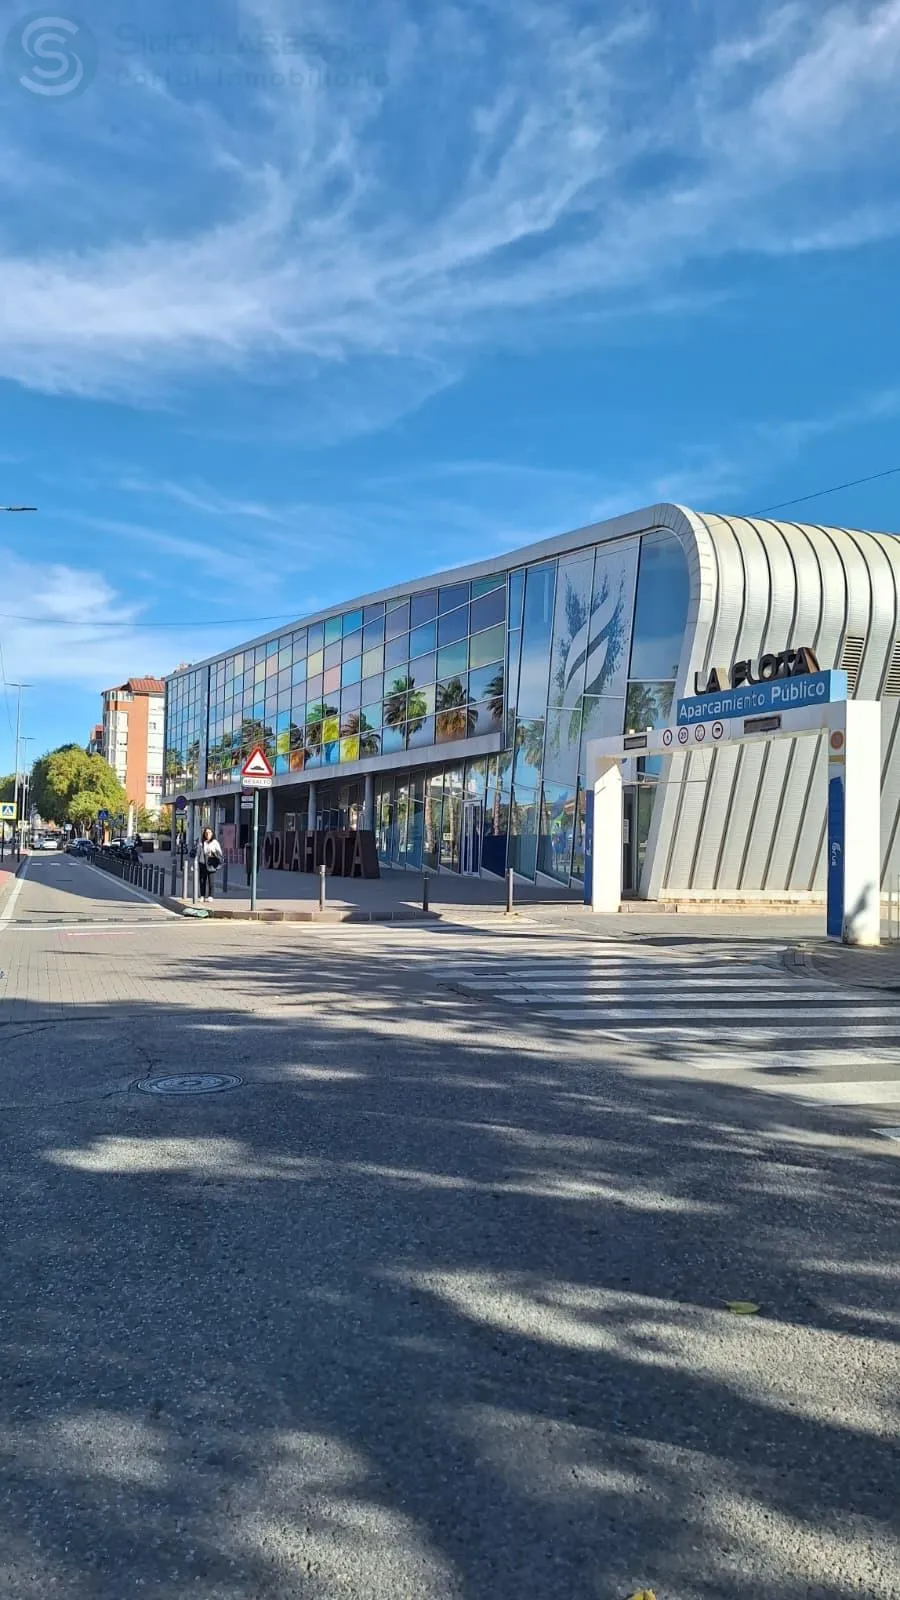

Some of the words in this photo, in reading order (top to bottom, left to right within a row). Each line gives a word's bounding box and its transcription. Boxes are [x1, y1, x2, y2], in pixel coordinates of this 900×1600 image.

[694, 667, 726, 696] LA
[730, 646, 820, 690] FLOTA
[679, 691, 765, 721] Aparcamiento
[770, 680, 826, 704] Público
